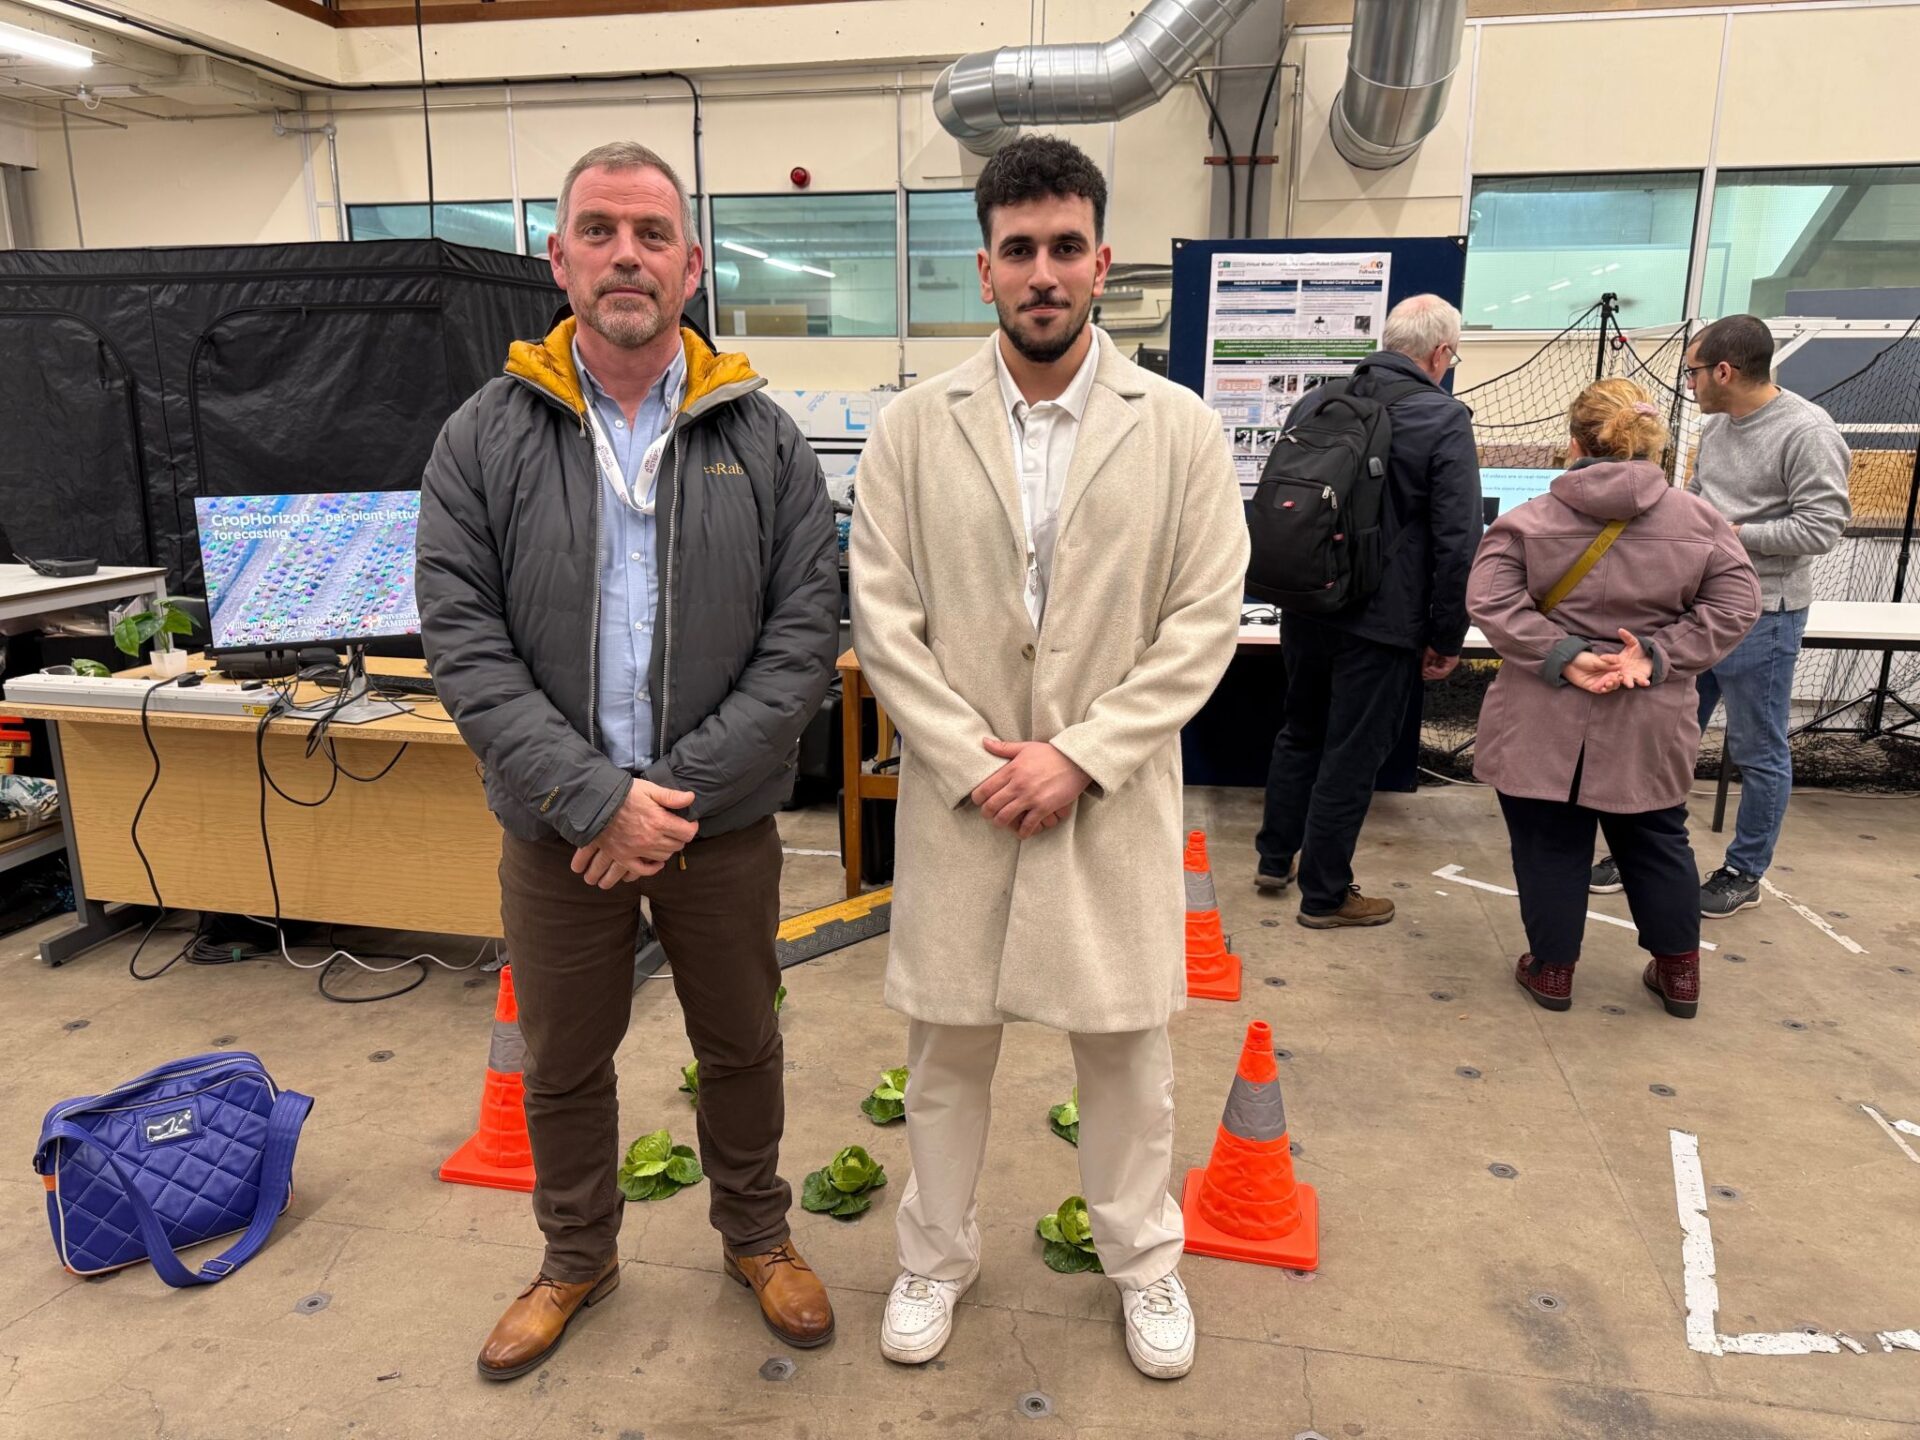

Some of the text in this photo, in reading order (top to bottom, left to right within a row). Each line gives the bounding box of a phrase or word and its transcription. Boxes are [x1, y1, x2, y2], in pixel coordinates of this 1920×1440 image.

[716, 462, 744, 475] Rab
[211, 511, 311, 530] CropHorizon
[325, 510, 385, 524] per-plant
[213, 528, 289, 542] forecasting
[224, 621, 261, 630] William
[298, 616, 326, 626] Fulvio
[265, 629, 299, 641] Project
[301, 626, 331, 638] Award
